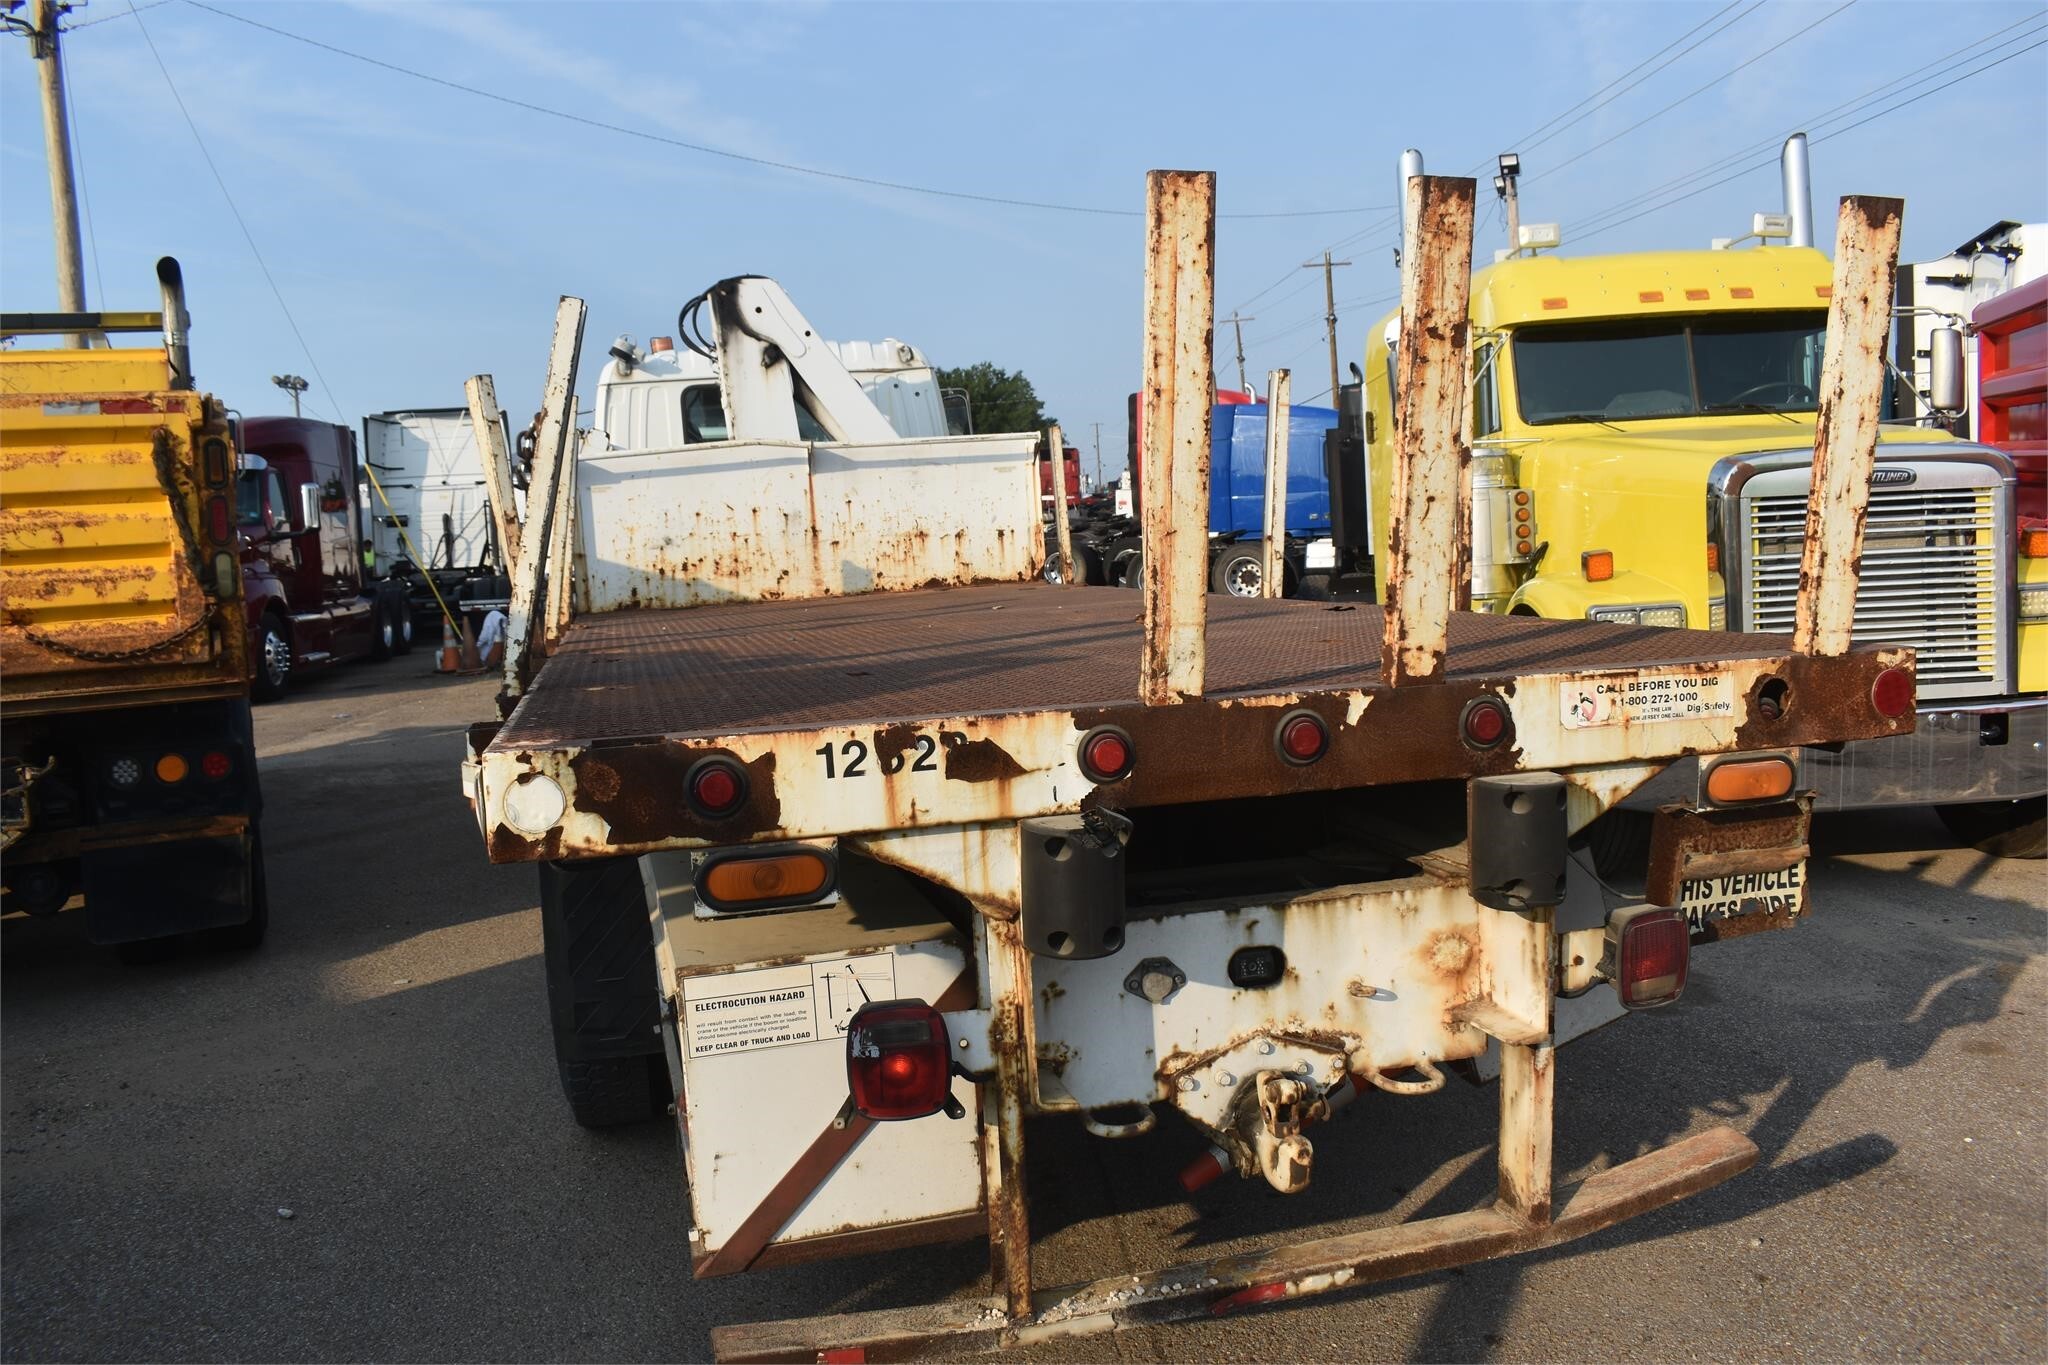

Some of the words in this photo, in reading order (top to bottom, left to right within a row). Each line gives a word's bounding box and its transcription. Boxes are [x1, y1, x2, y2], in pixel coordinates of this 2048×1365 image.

[1596, 683, 1625, 695] CALL
[1628, 680, 1671, 692] BEFORE
[1675, 678, 1698, 689] YOU
[1701, 676, 1719, 687] DIG
[1620, 695, 1648, 706] 1-800
[1651, 692, 1698, 704] 272-1000
[1687, 703, 1701, 713] Dig
[1641, 713, 1660, 721] JERSEY
[815, 731, 968, 779] 122
[1720, 863, 1801, 897] VEHICLE
[695, 996, 766, 1012] ELECTROCUTION
[769, 991, 805, 1002] HAZARD
[738, 1015, 759, 1023] contact
[763, 1018, 779, 1026] boom
[786, 1015, 807, 1023] loadline
[697, 1033, 716, 1041] should
[716, 1030, 738, 1038] become
[738, 1026, 767, 1036] electrically
[695, 1043, 714, 1053] KEEP
[715, 1040, 738, 1050] CLEAR
[740, 1039, 749, 1047] OF
[751, 1035, 774, 1045] TRUCK
[776, 1033, 791, 1042] AND
[792, 1031, 811, 1040] LOAD
